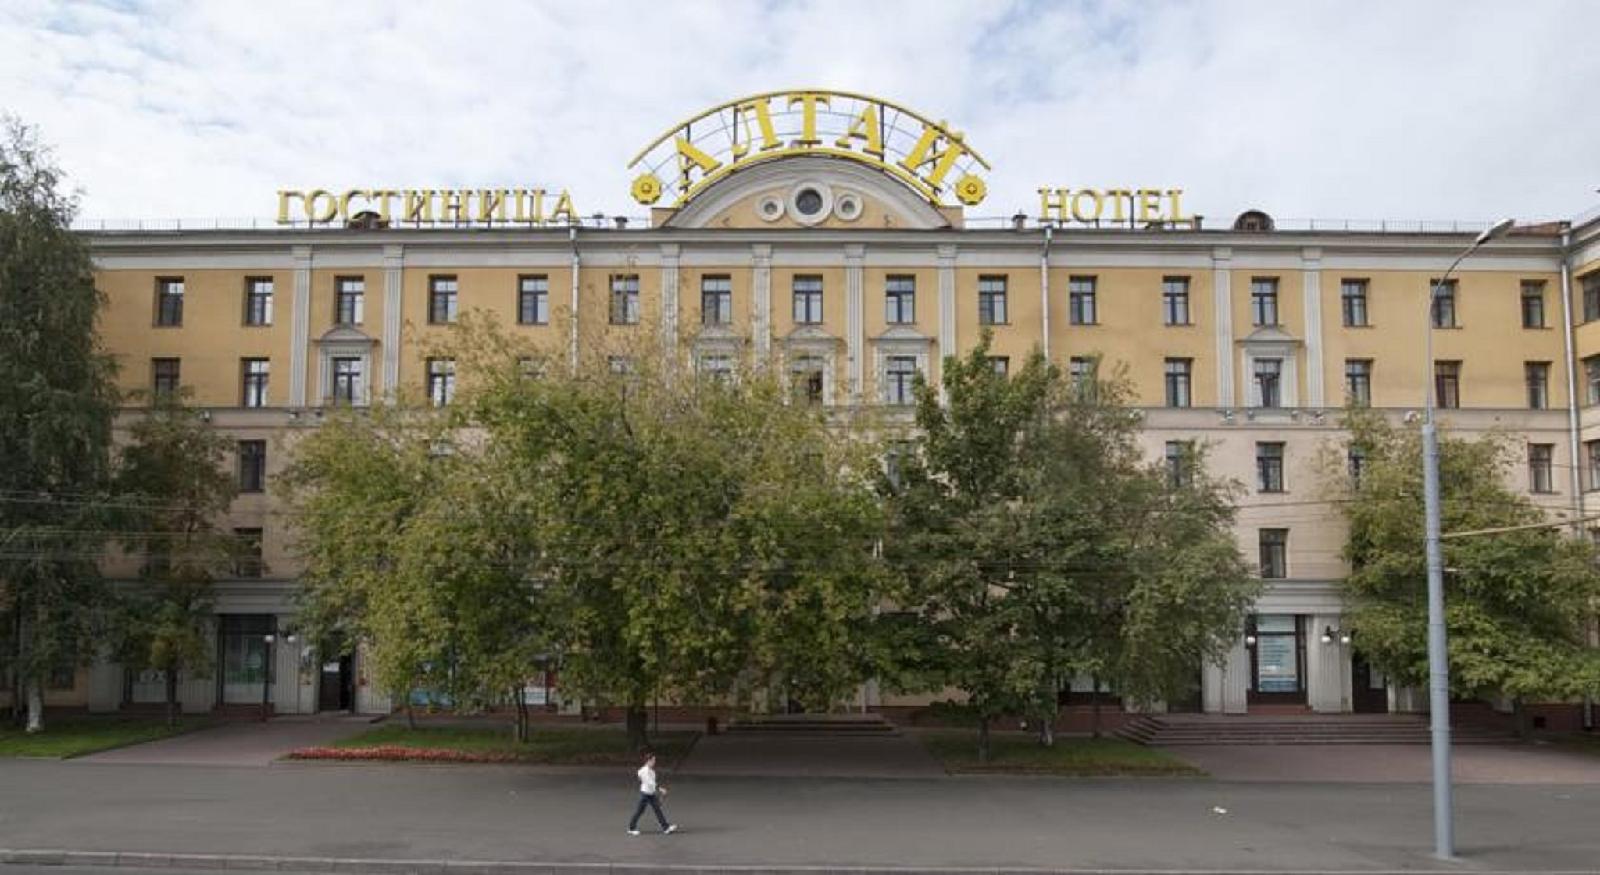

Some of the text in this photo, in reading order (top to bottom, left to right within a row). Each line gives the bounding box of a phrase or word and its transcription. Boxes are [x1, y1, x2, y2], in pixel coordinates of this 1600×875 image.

[674, 94, 967, 188] АЛТАЙ
[277, 188, 580, 224] ГОСТИНИЦА
[1037, 187, 1193, 223] HOTEL
